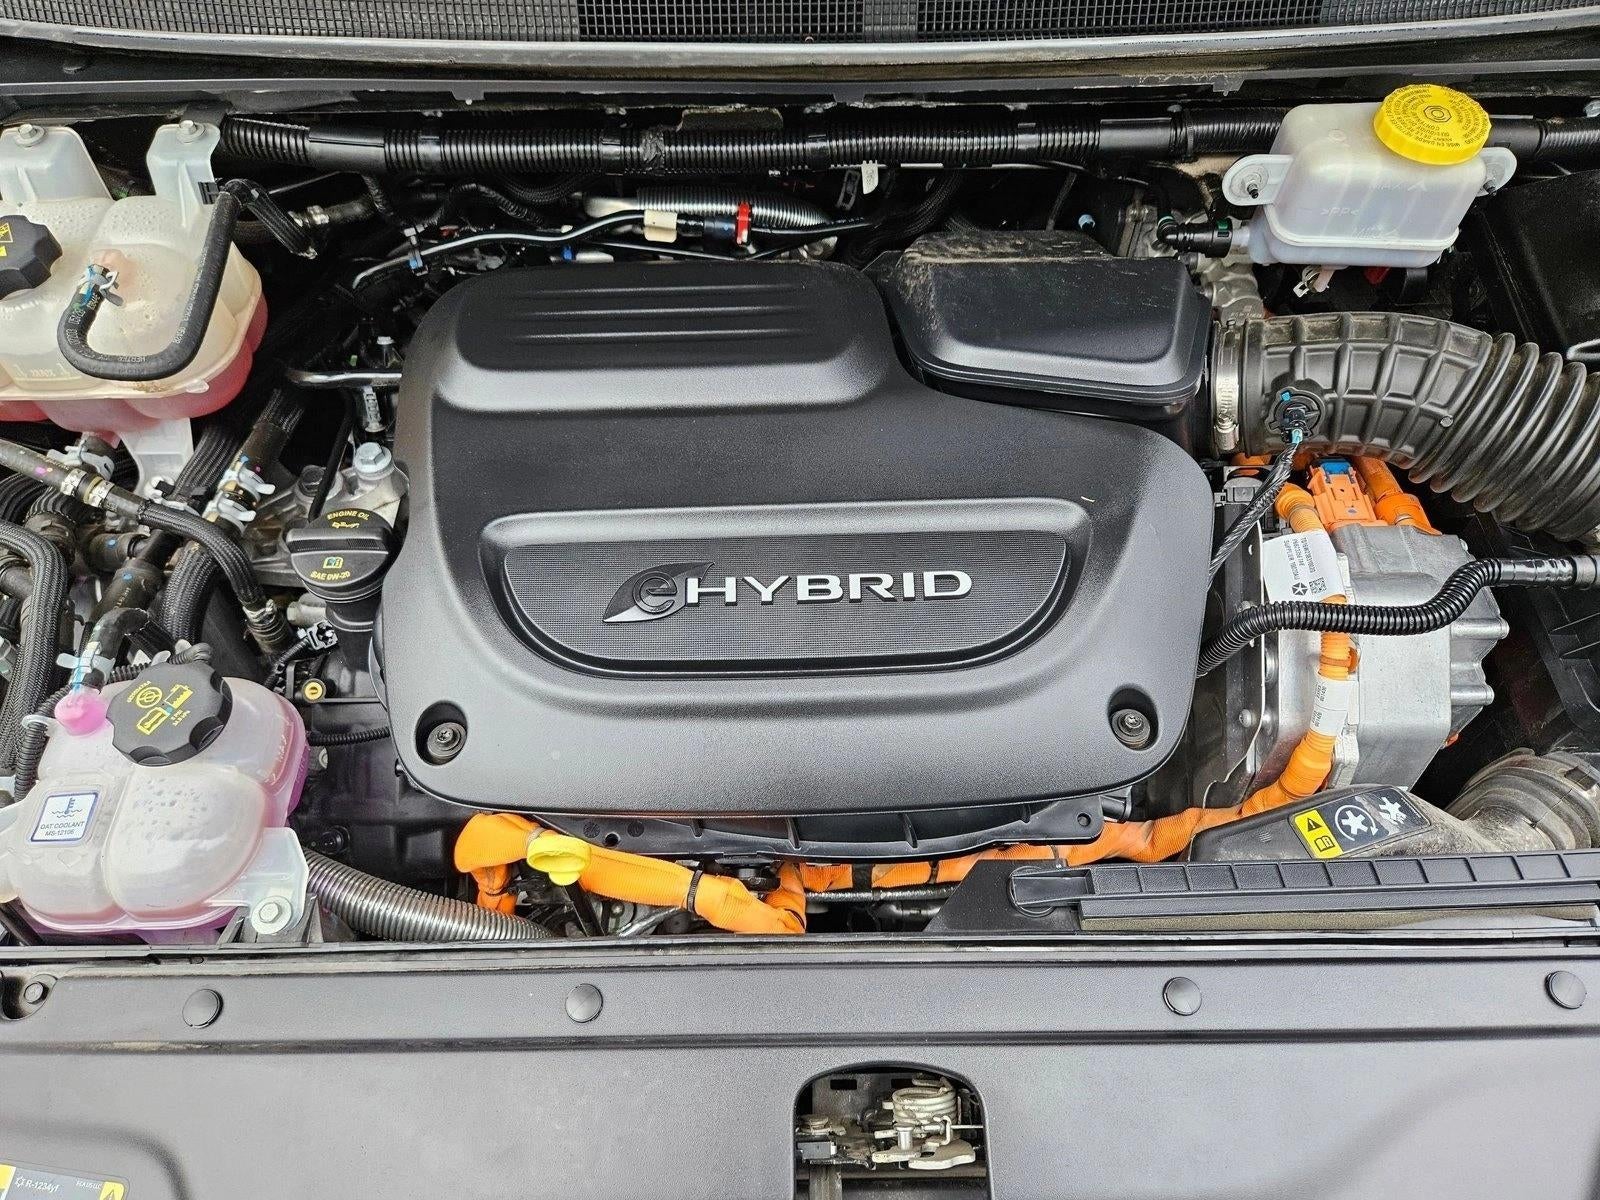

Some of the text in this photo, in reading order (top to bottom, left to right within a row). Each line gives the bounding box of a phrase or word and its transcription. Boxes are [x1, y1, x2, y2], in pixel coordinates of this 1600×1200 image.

[327, 510, 370, 521] ENGINE OIL
[310, 570, 326, 580] SAE
[53, 821, 86, 829] COOLANT
[25, 1179, 60, 1192] R-1234yf
